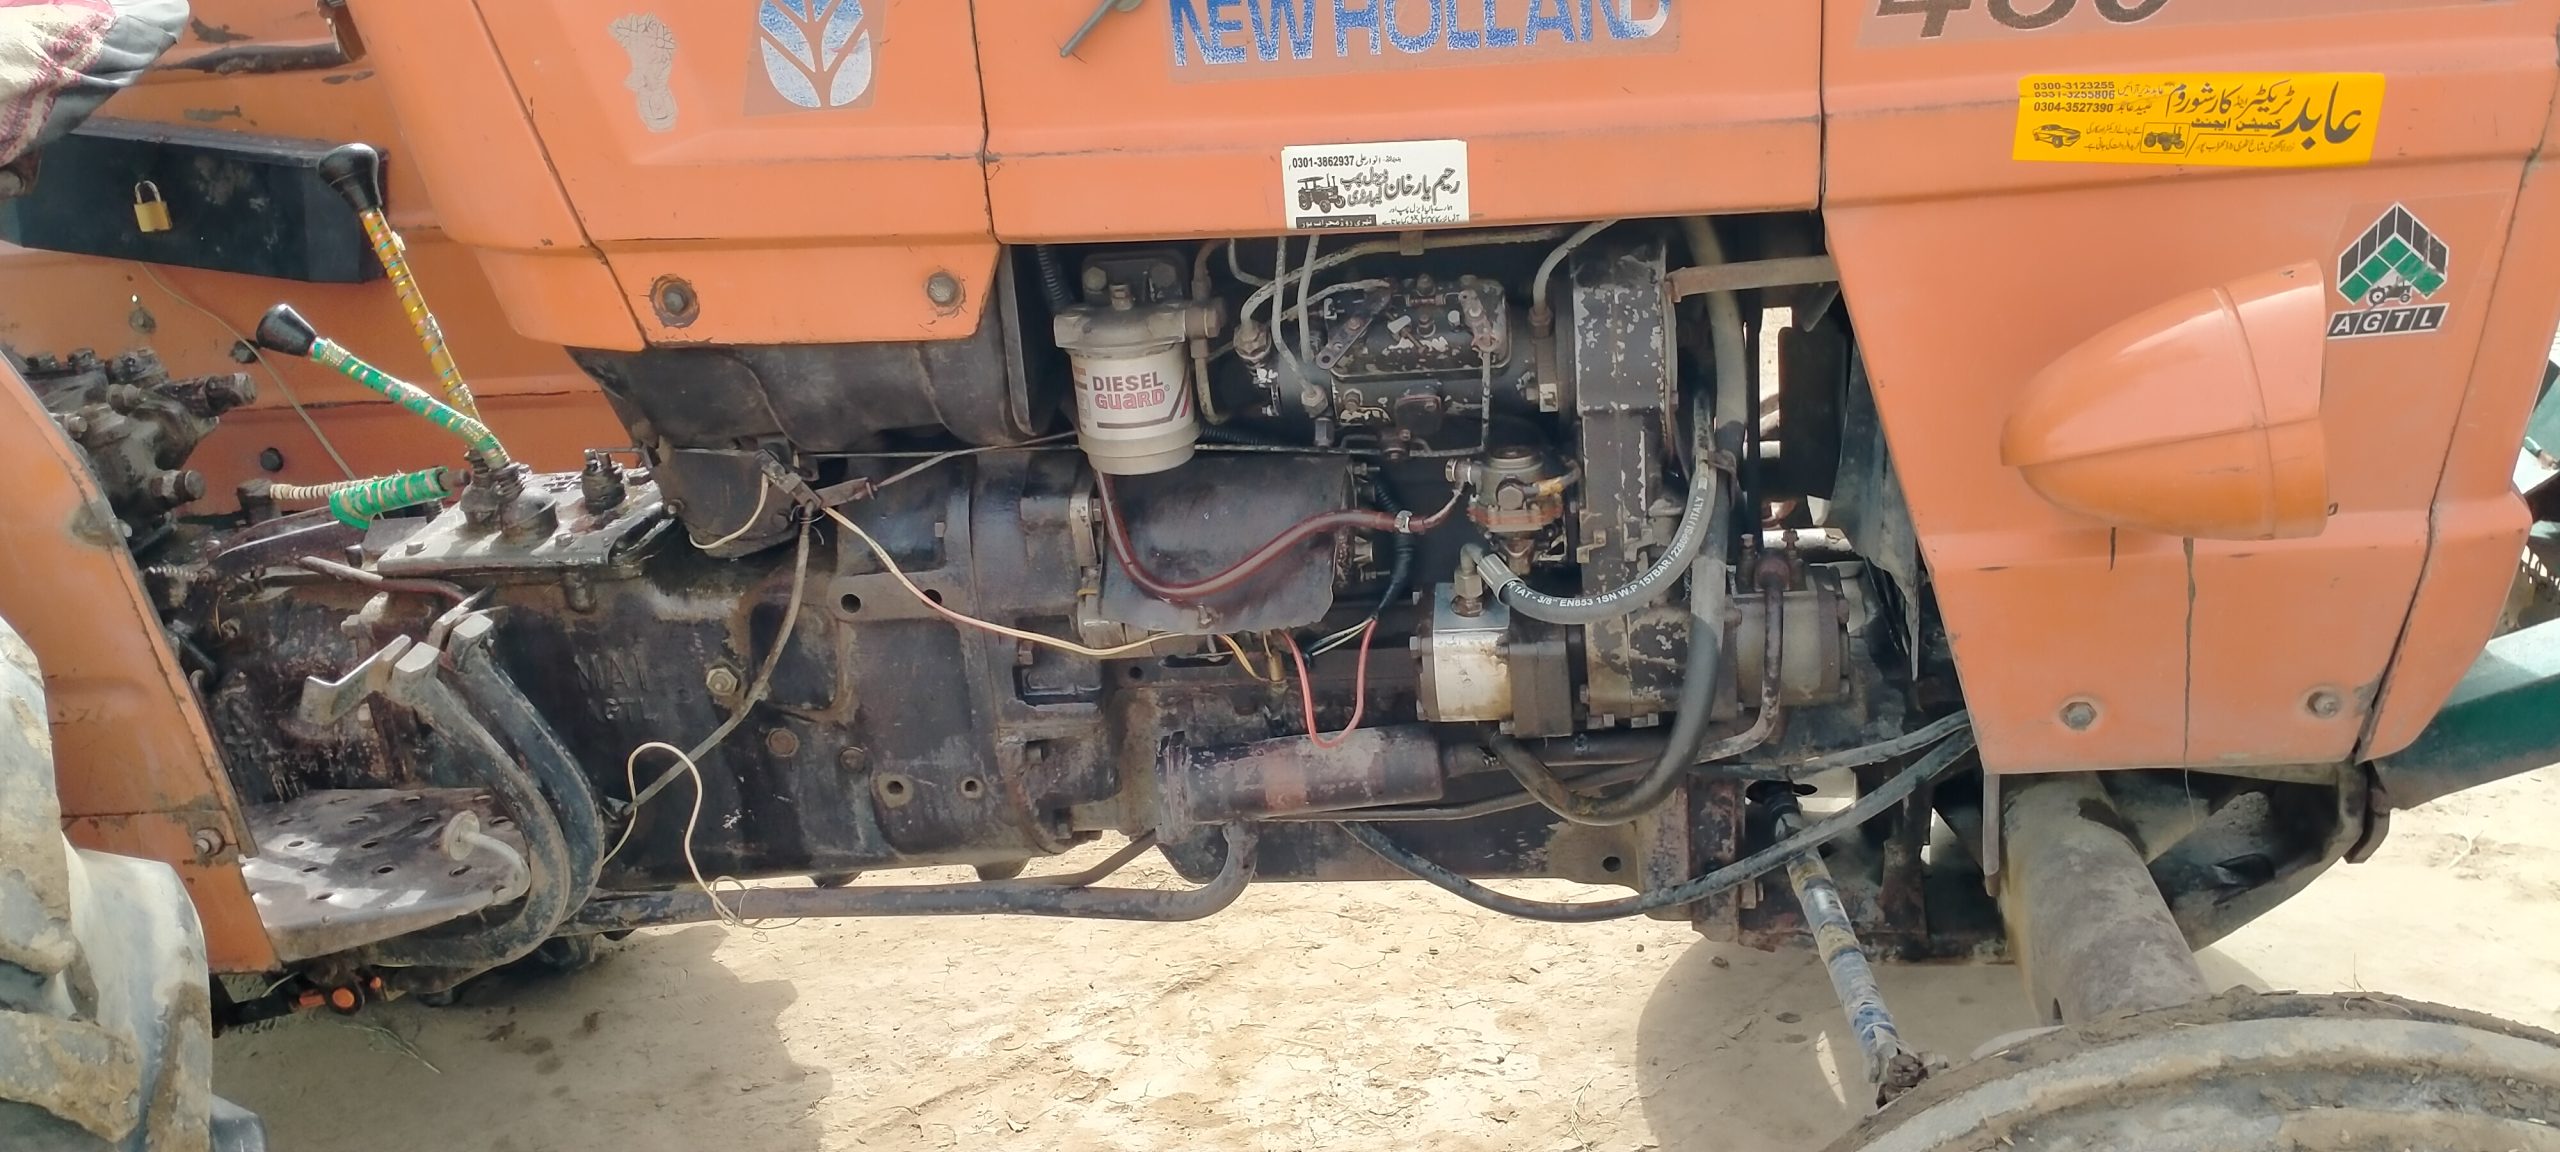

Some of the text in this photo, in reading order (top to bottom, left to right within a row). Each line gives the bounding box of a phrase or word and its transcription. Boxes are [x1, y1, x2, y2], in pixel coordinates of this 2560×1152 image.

[1169, 0, 1315, 66] NEW
[2034, 82, 2115, 90] 0300-3123255
[2034, 102, 2114, 112] 0304-3527390
[2271, 81, 2362, 151] عابد
[1292, 155, 1355, 168] 0301-3862937
[2333, 309, 2432, 334] AGTL
[1092, 371, 1164, 392] DIESEL
[1559, 598, 1593, 607] EN853
[1596, 593, 1618, 604] 1SN
[1639, 558, 1671, 588] 157BAR
